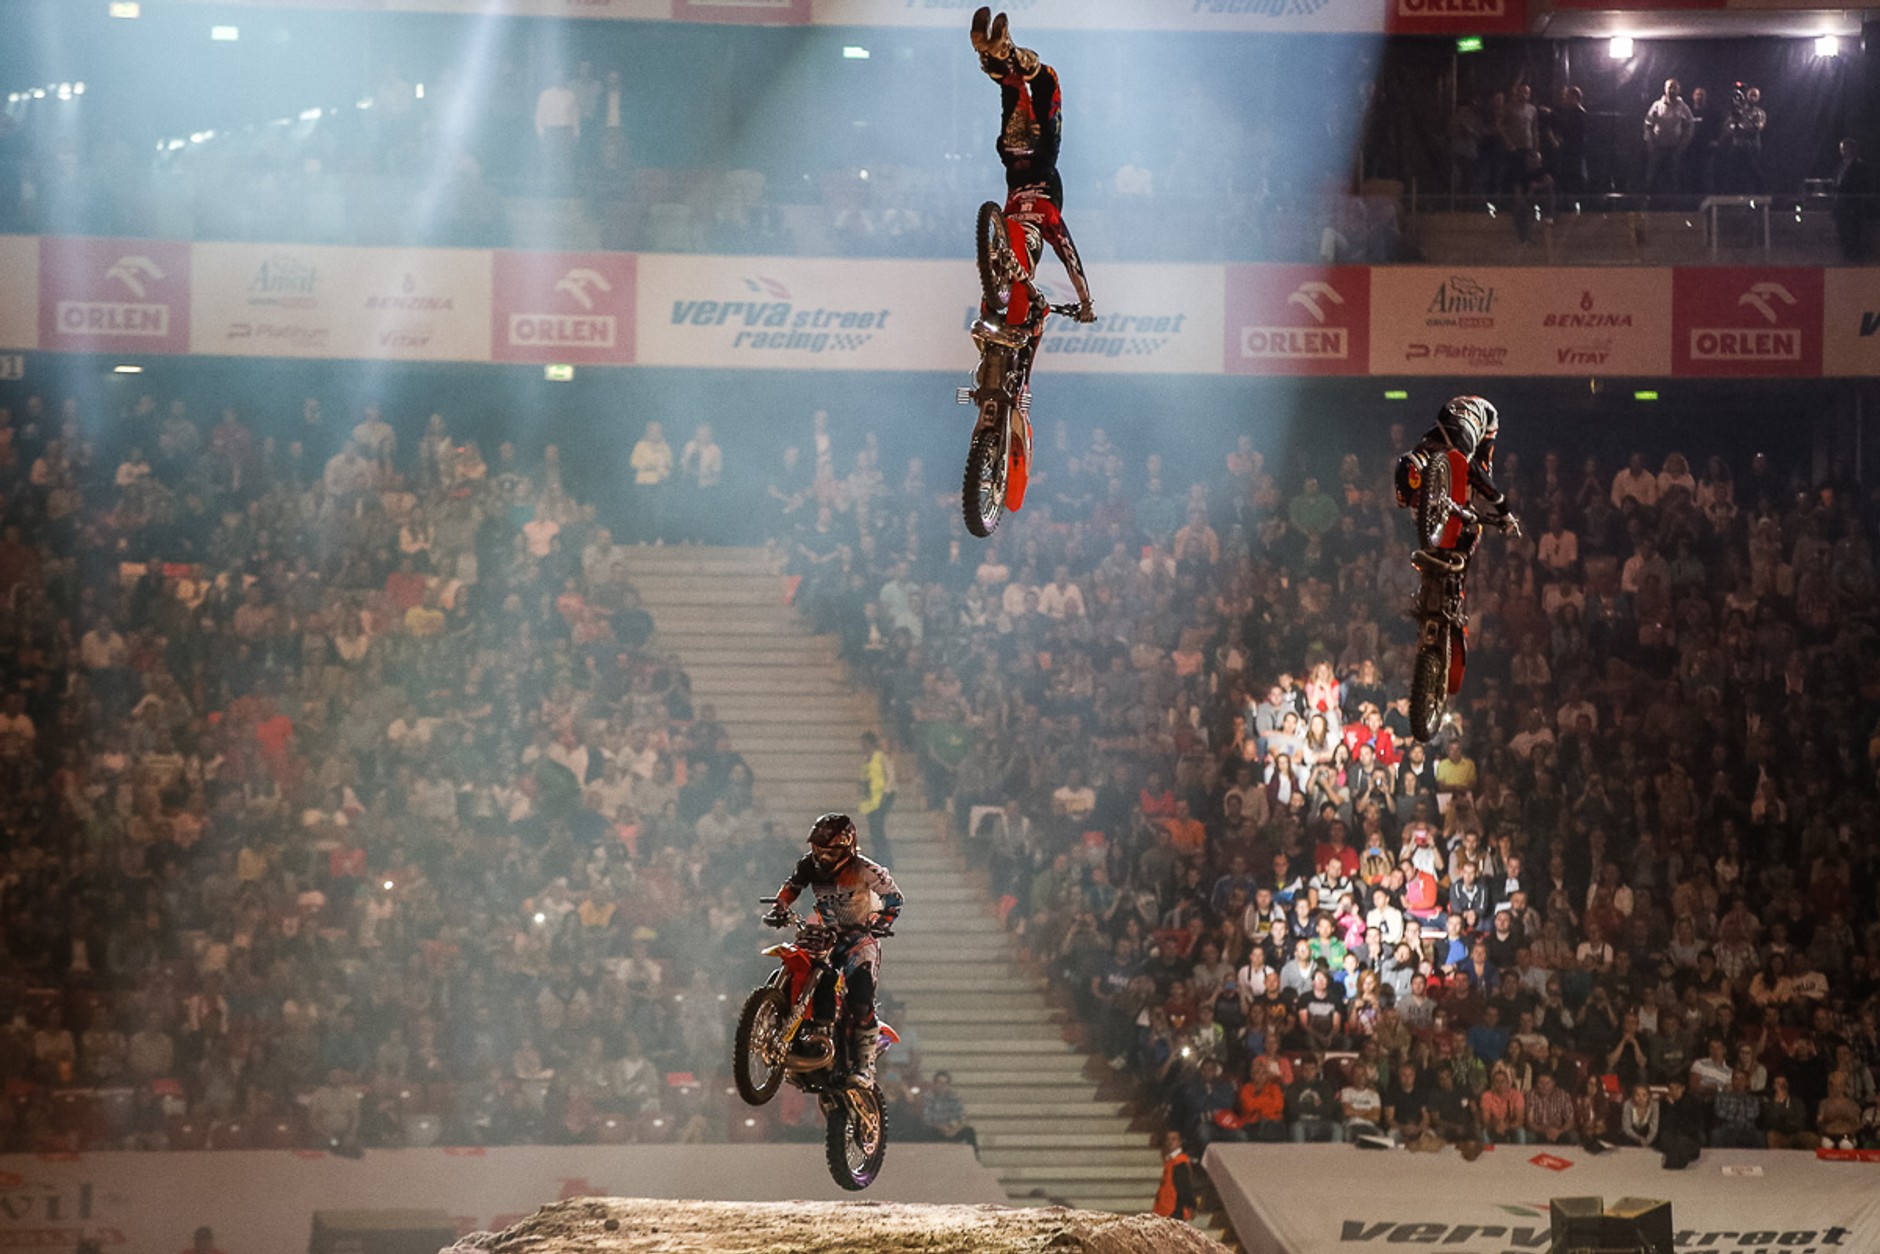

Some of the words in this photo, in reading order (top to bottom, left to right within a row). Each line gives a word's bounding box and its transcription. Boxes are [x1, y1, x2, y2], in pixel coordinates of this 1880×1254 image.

[1427, 281, 1494, 313] Anwil
[64, 306, 162, 331] ORLEN
[671, 299, 792, 327] verva
[791, 308, 891, 329] street
[1543, 313, 1632, 327] BENZINA
[515, 319, 609, 341] ORLEN
[733, 329, 829, 352] racing
[1247, 331, 1341, 354] ORLEN
[1433, 344, 1508, 358] Platinum
[1696, 332, 1794, 355] ORLEN
[1340, 1220, 1551, 1248] verv
[1674, 1226, 1852, 1247] treet
